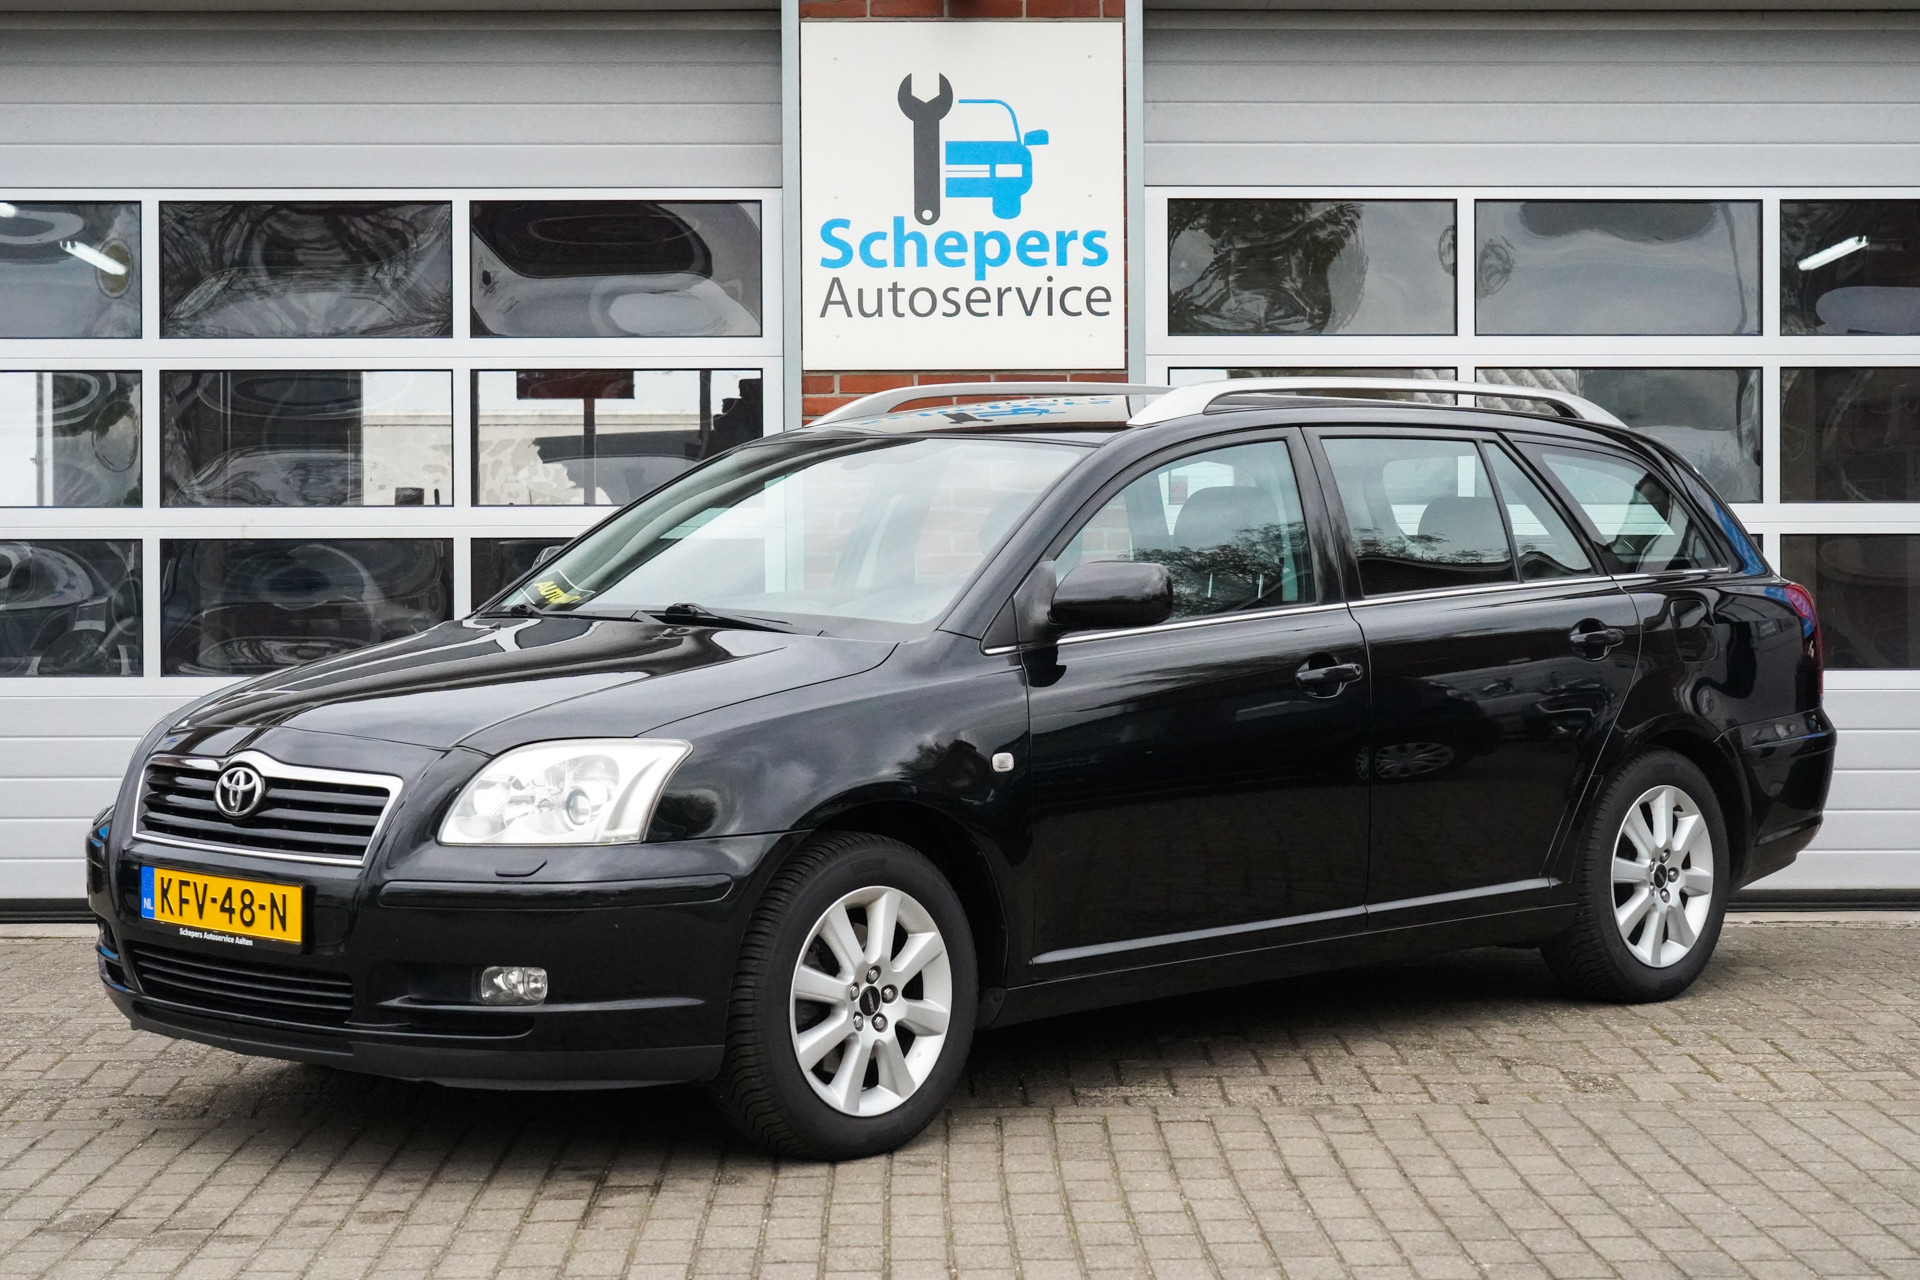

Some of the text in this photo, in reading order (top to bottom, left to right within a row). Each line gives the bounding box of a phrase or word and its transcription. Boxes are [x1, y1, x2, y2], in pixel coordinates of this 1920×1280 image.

[819, 216, 1109, 281] Schepers
[819, 275, 1112, 318] Autoservice
[143, 897, 154, 910] NL
[160, 876, 287, 932] KFV-48-N
[179, 927, 254, 946] Schepers Autoservice Aalten
